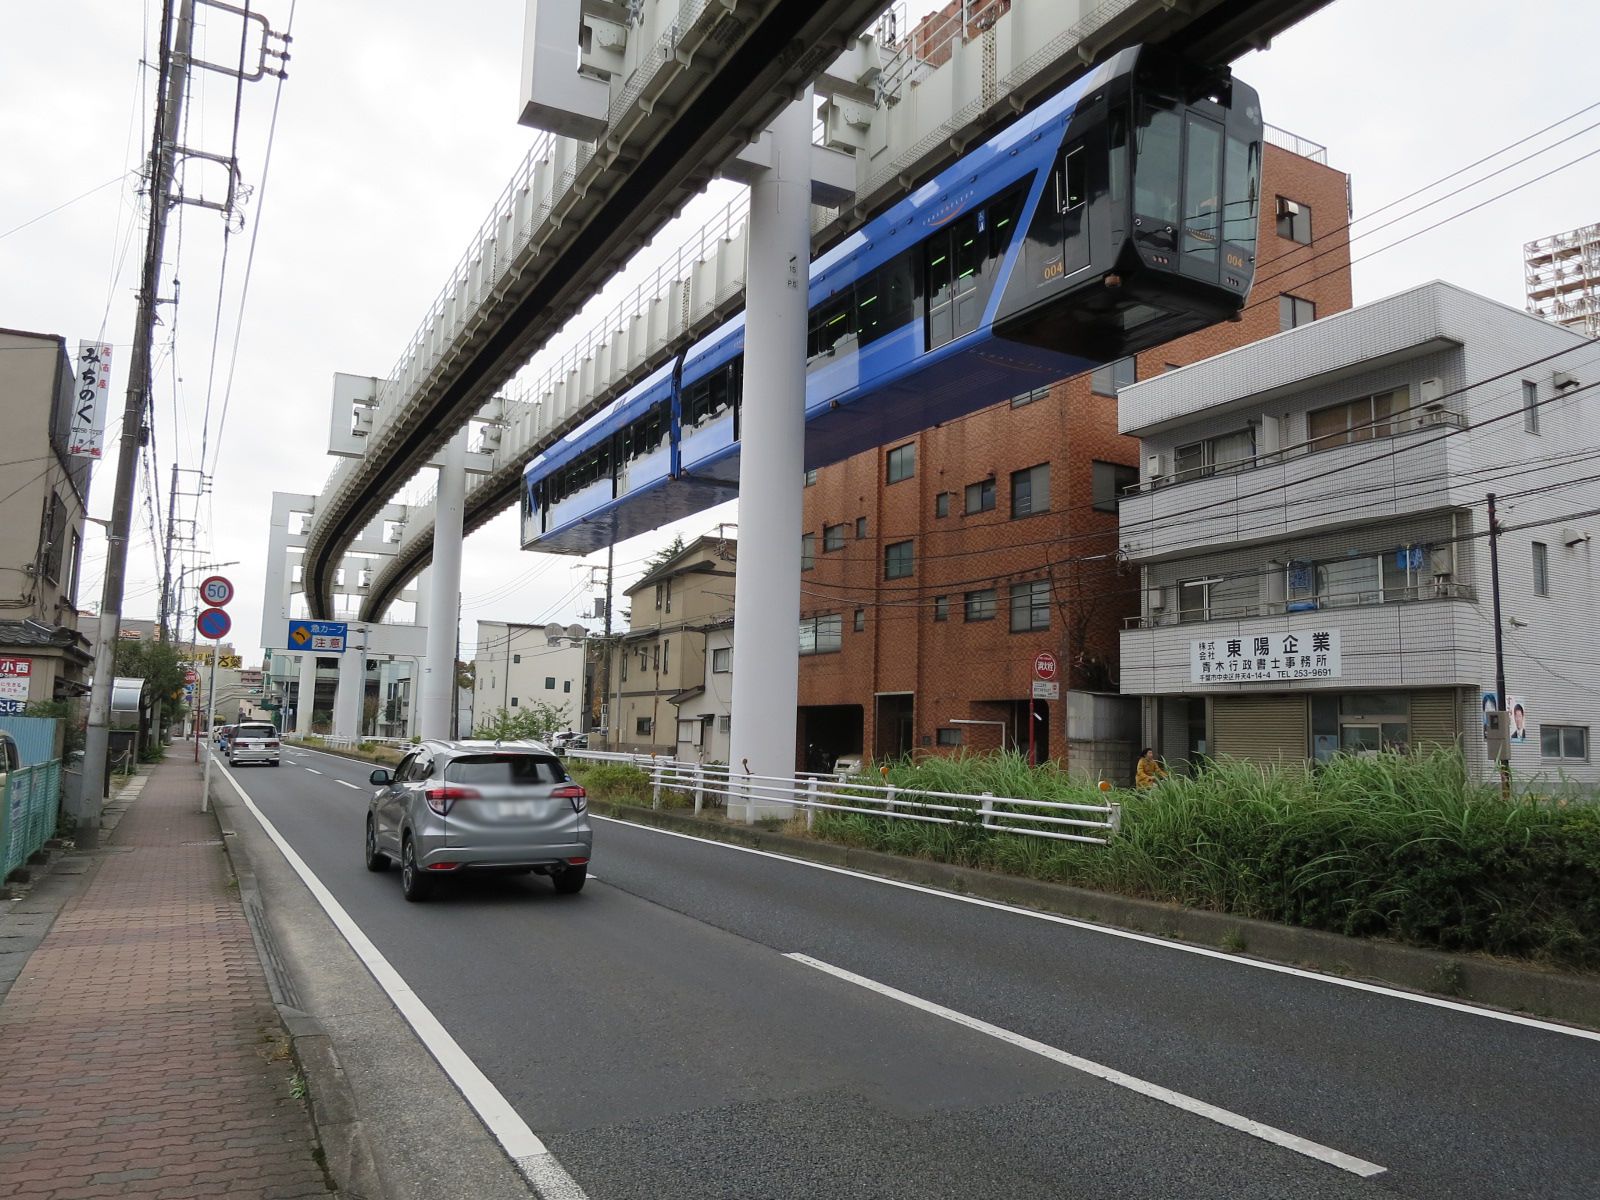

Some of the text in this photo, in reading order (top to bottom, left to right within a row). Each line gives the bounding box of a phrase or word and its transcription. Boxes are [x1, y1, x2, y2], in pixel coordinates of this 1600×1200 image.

[1227, 254, 1243, 268] 004
[1044, 261, 1062, 279] 004
[77, 347, 101, 424] みちのく
[207, 584, 227, 599] 50
[314, 638, 341, 649] 注意
[1226, 631, 1331, 658] 東陽企業
[1, 661, 29, 673] 小西
[1201, 654, 1328, 673] 青木行政書士事務所
[1277, 670, 1291, 678] TEL
[1293, 668, 1332, 678] 253-9691
